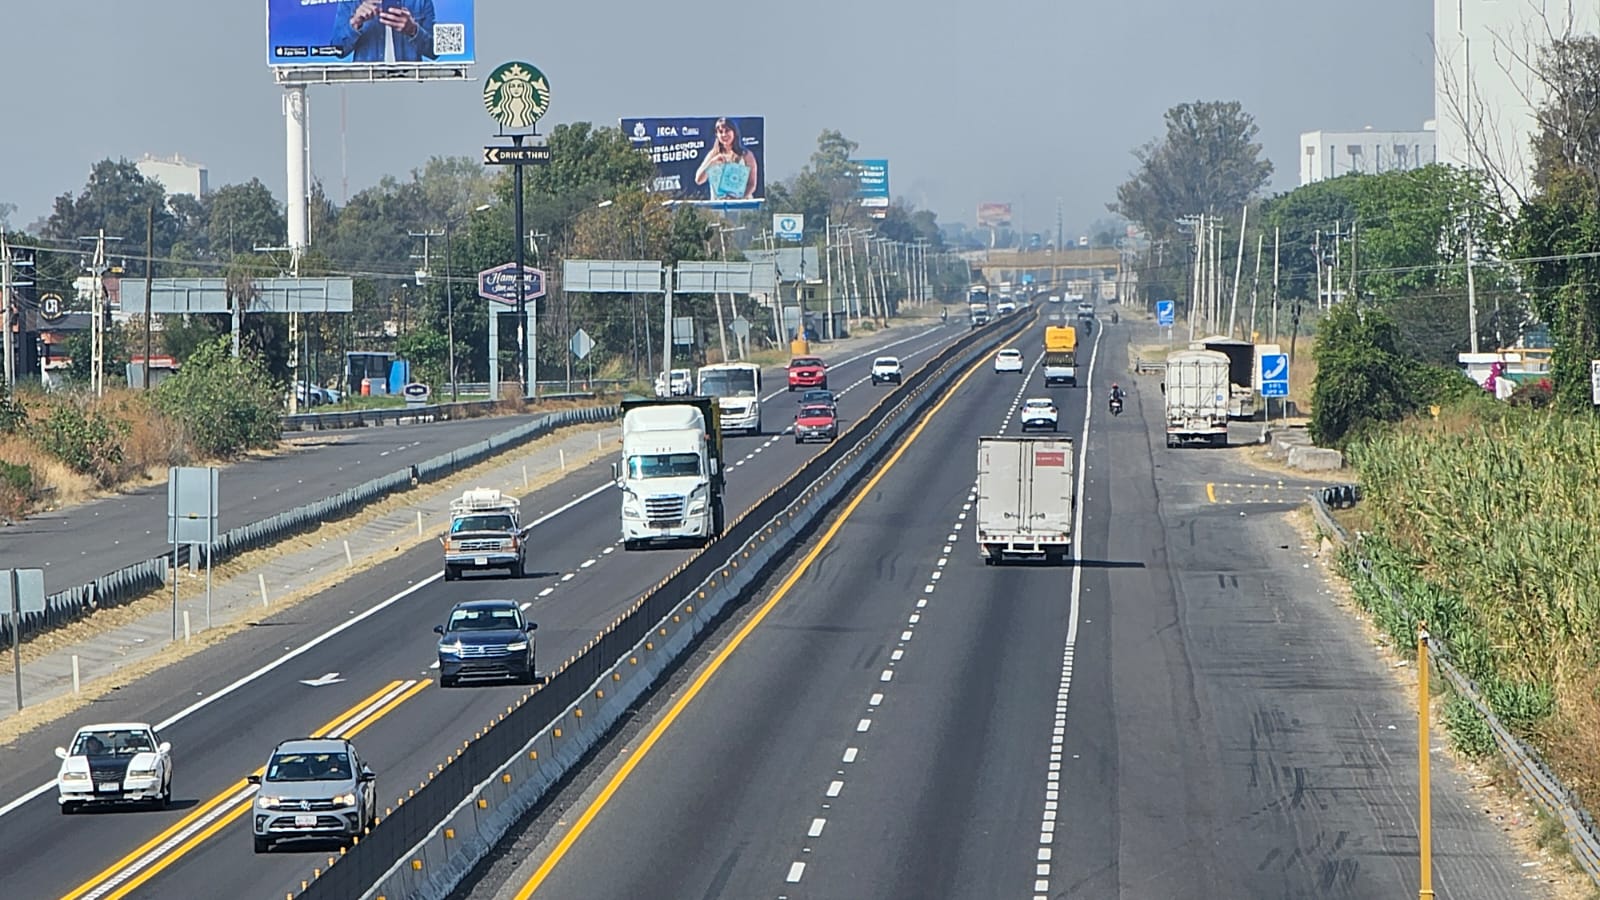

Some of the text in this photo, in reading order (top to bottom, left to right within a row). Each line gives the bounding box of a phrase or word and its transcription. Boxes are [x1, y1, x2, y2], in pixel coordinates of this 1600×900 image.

[500, 151, 549, 160] DRIVE THRU
[662, 149, 698, 163] SUEÑO
